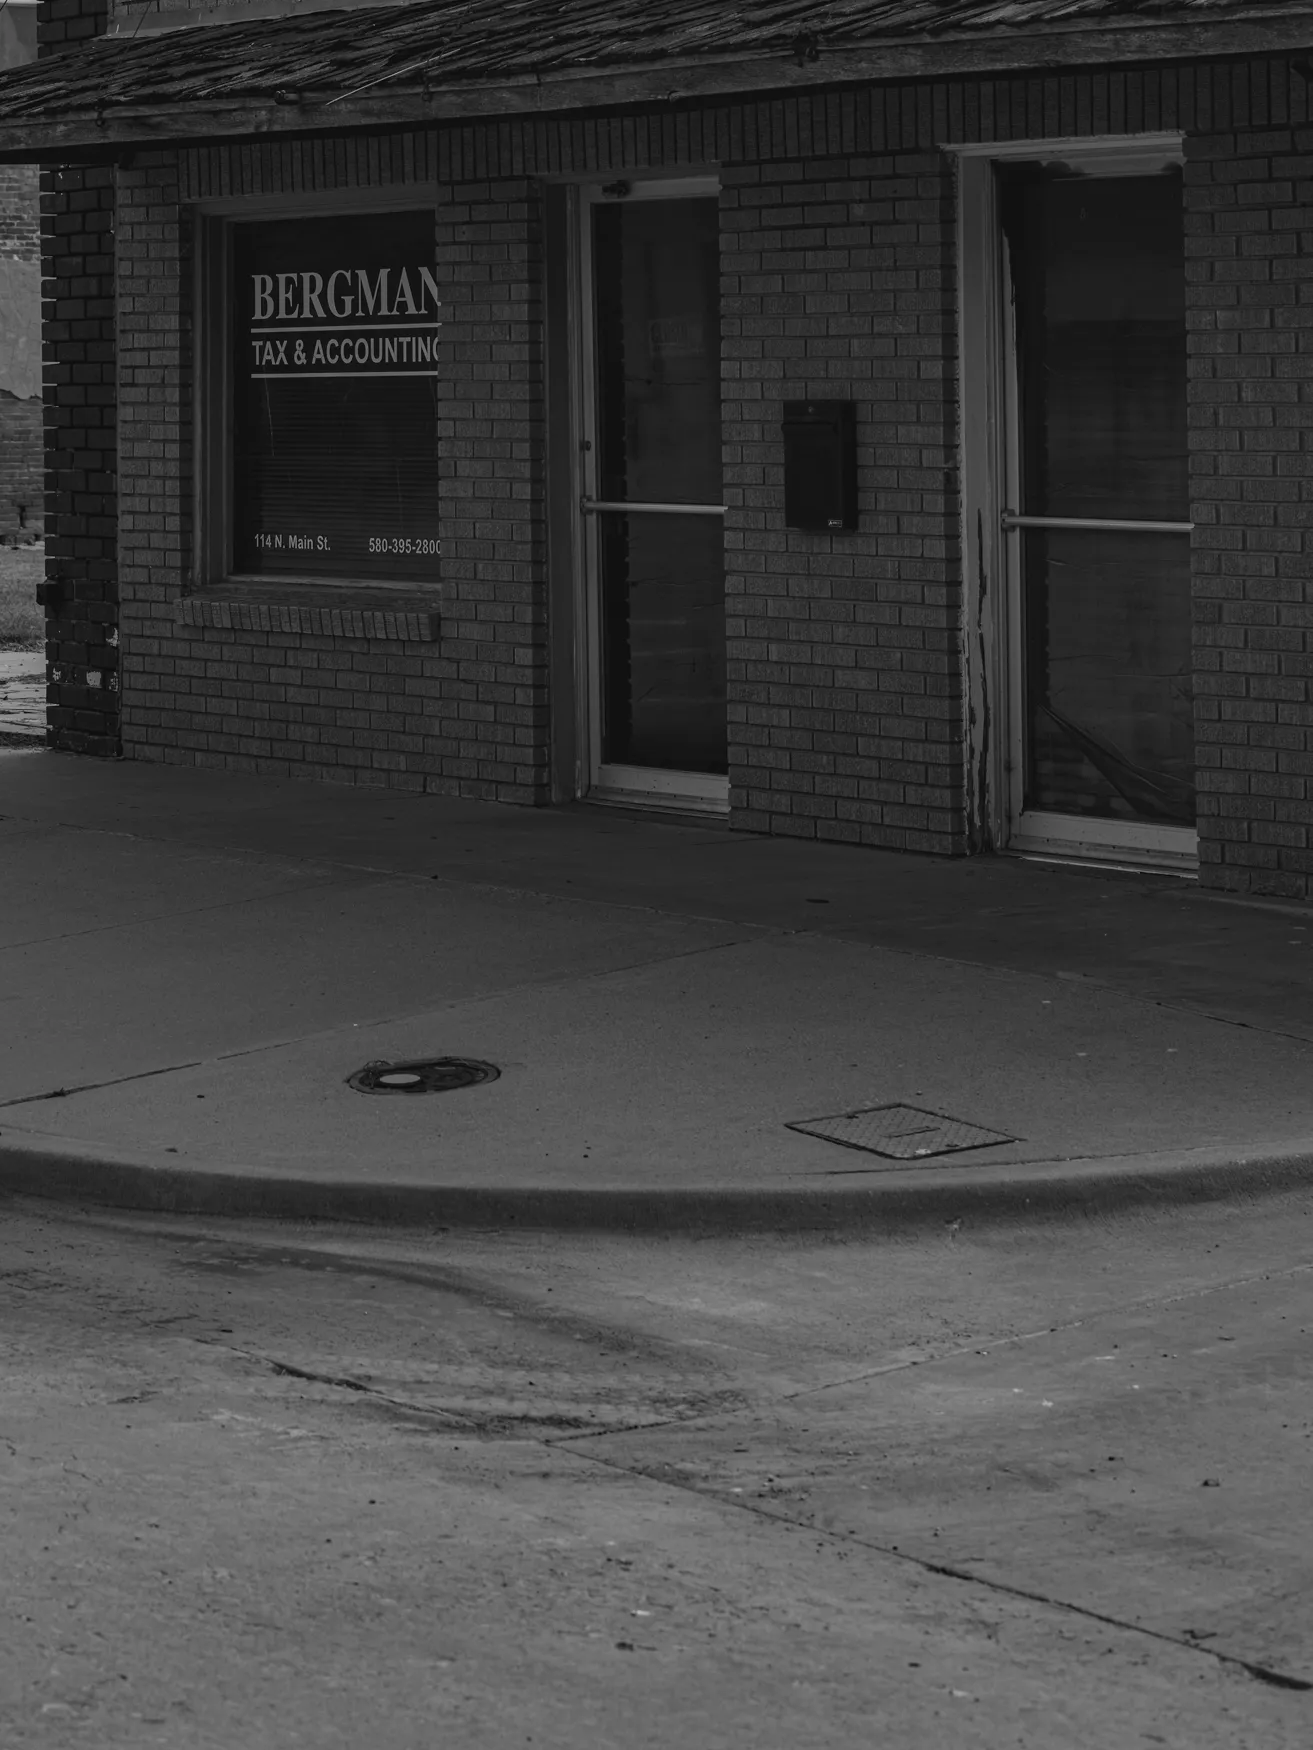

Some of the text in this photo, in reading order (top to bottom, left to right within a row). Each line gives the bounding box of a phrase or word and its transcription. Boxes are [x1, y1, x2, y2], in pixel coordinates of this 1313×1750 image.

[251, 266, 440, 320] BERGMAN
[251, 339, 289, 365] TAX
[293, 339, 307, 365] &
[254, 533, 331, 551] 114 N. Main St.
